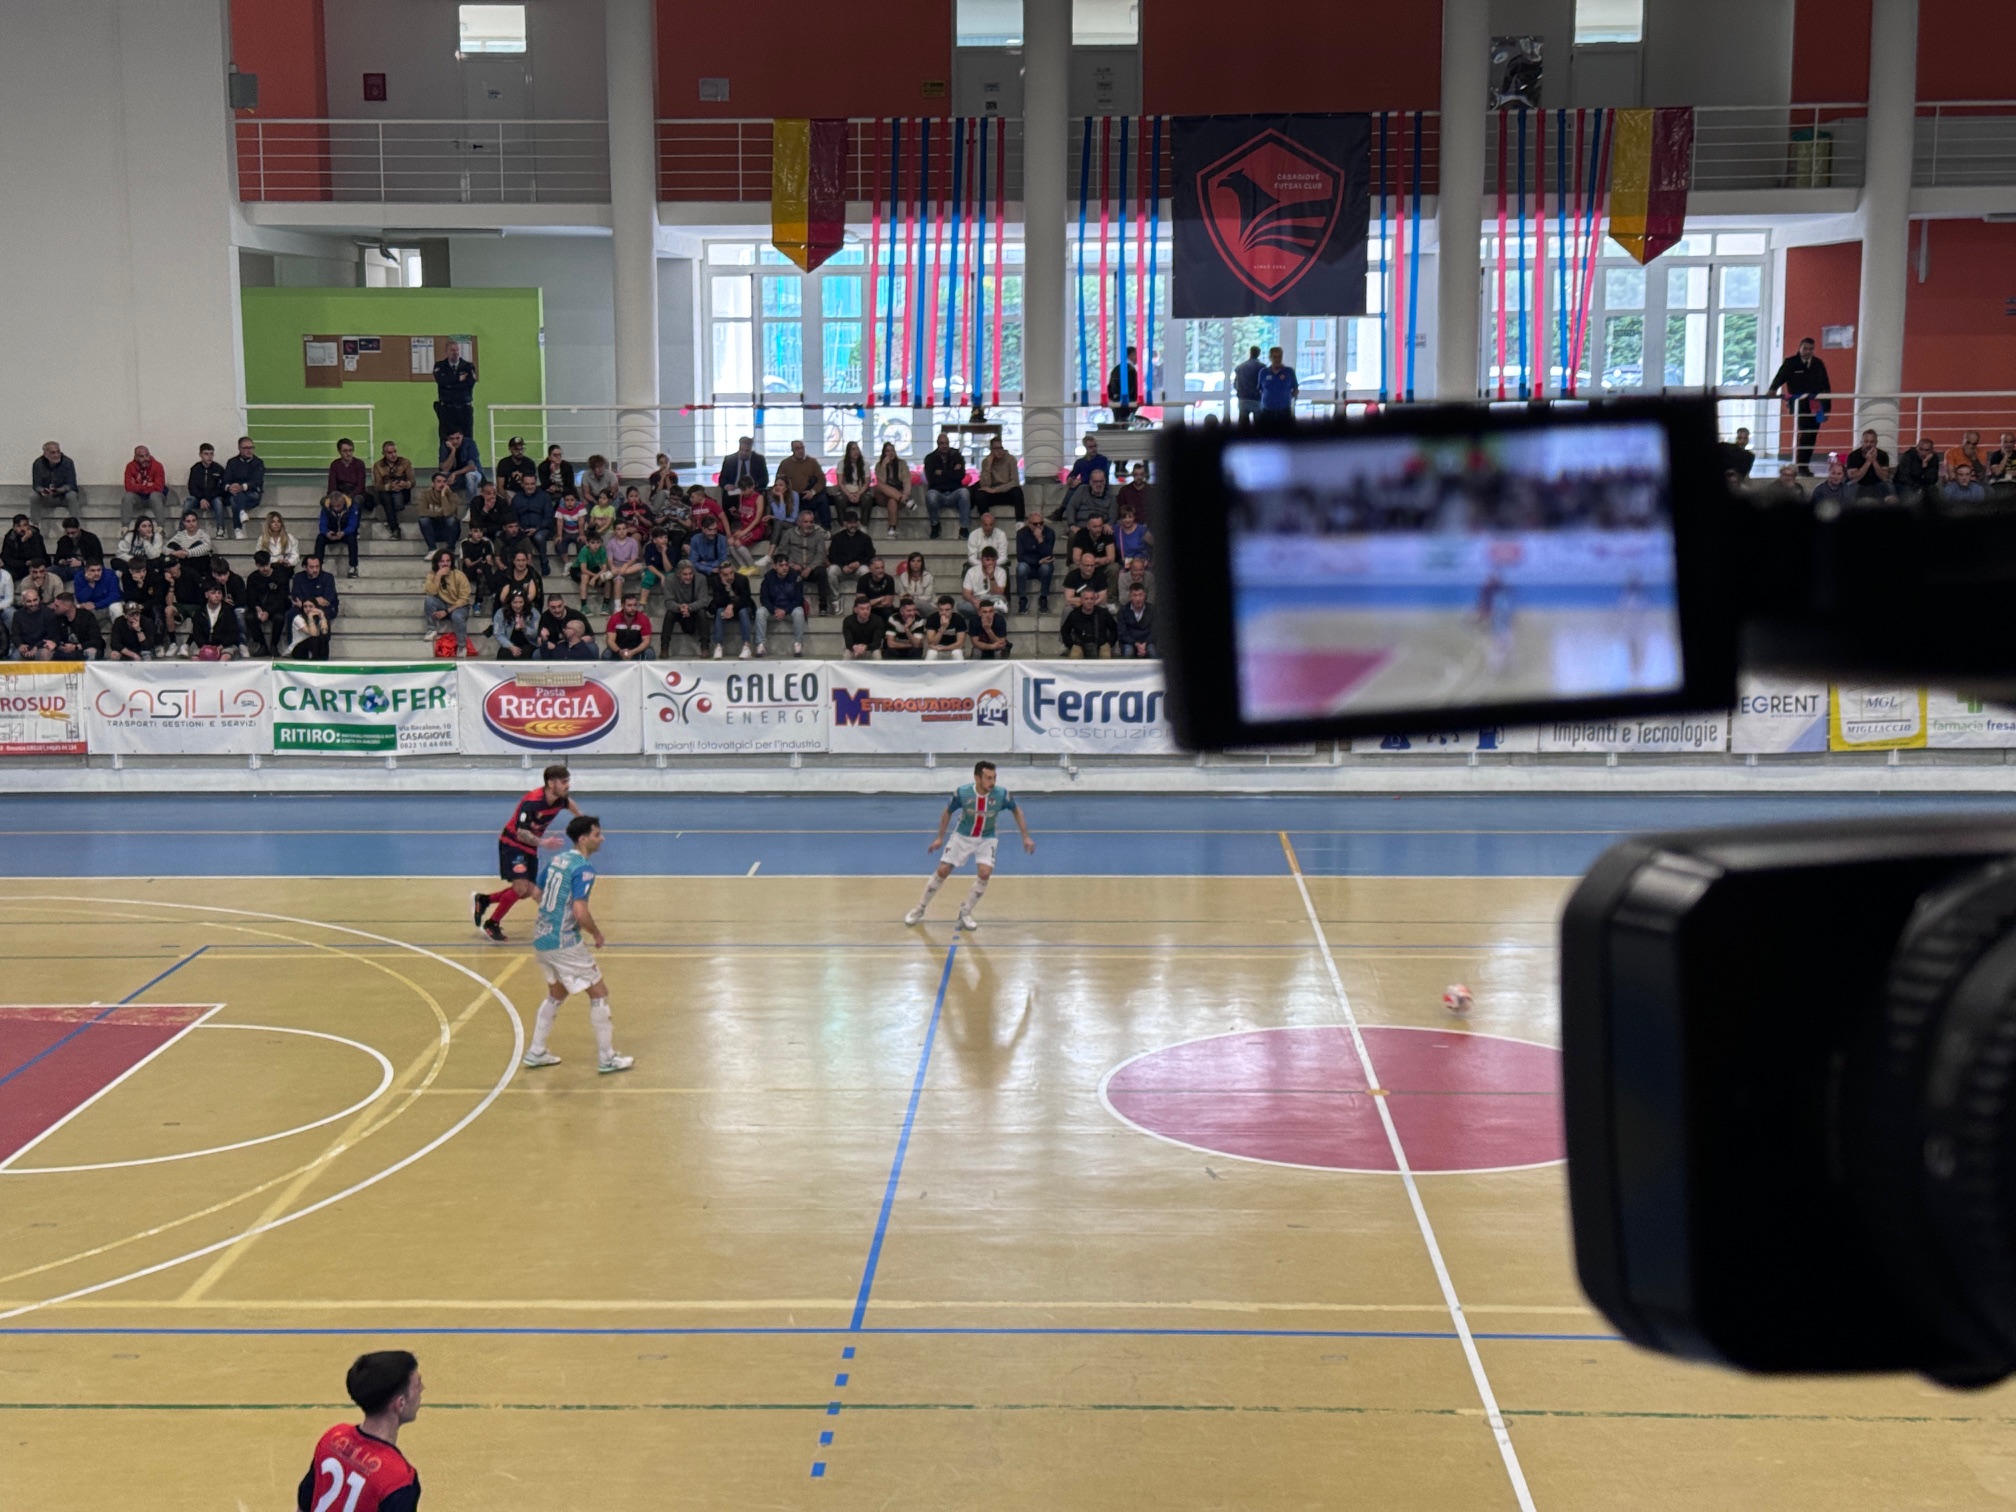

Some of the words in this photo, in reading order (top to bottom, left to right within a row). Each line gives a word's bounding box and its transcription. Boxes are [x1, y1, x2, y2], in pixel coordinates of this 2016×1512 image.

[1276, 173, 1321, 181] CASAGIOVE
[1273, 182, 1302, 190] FUTSAL
[1303, 182, 1323, 190] CLUB
[535, 687, 566, 698] Pasta
[726, 672, 819, 703] GALEO
[95, 689, 265, 718] CASILLO
[498, 695, 603, 720] REGGIA
[832, 687, 973, 727] METROQUADRO
[1033, 677, 1166, 723] Ferrar
[1865, 695, 1899, 710] MGL
[209, 720, 216, 728] E
[726, 709, 820, 725] ENERGY
[1847, 723, 1912, 734] MIGLIACCIO
[1933, 719, 1983, 731] farmacia
[280, 728, 341, 744] RITIRO:
[400, 731, 452, 741] CASAGIOVE
[1553, 722, 1618, 747] Impianti
[1622, 728, 1631, 742] e
[1637, 721, 1717, 748] Tecnologie
[655, 741, 695, 751] Impianti
[755, 741, 772, 751] per
[313, 1457, 366, 1512] 21
